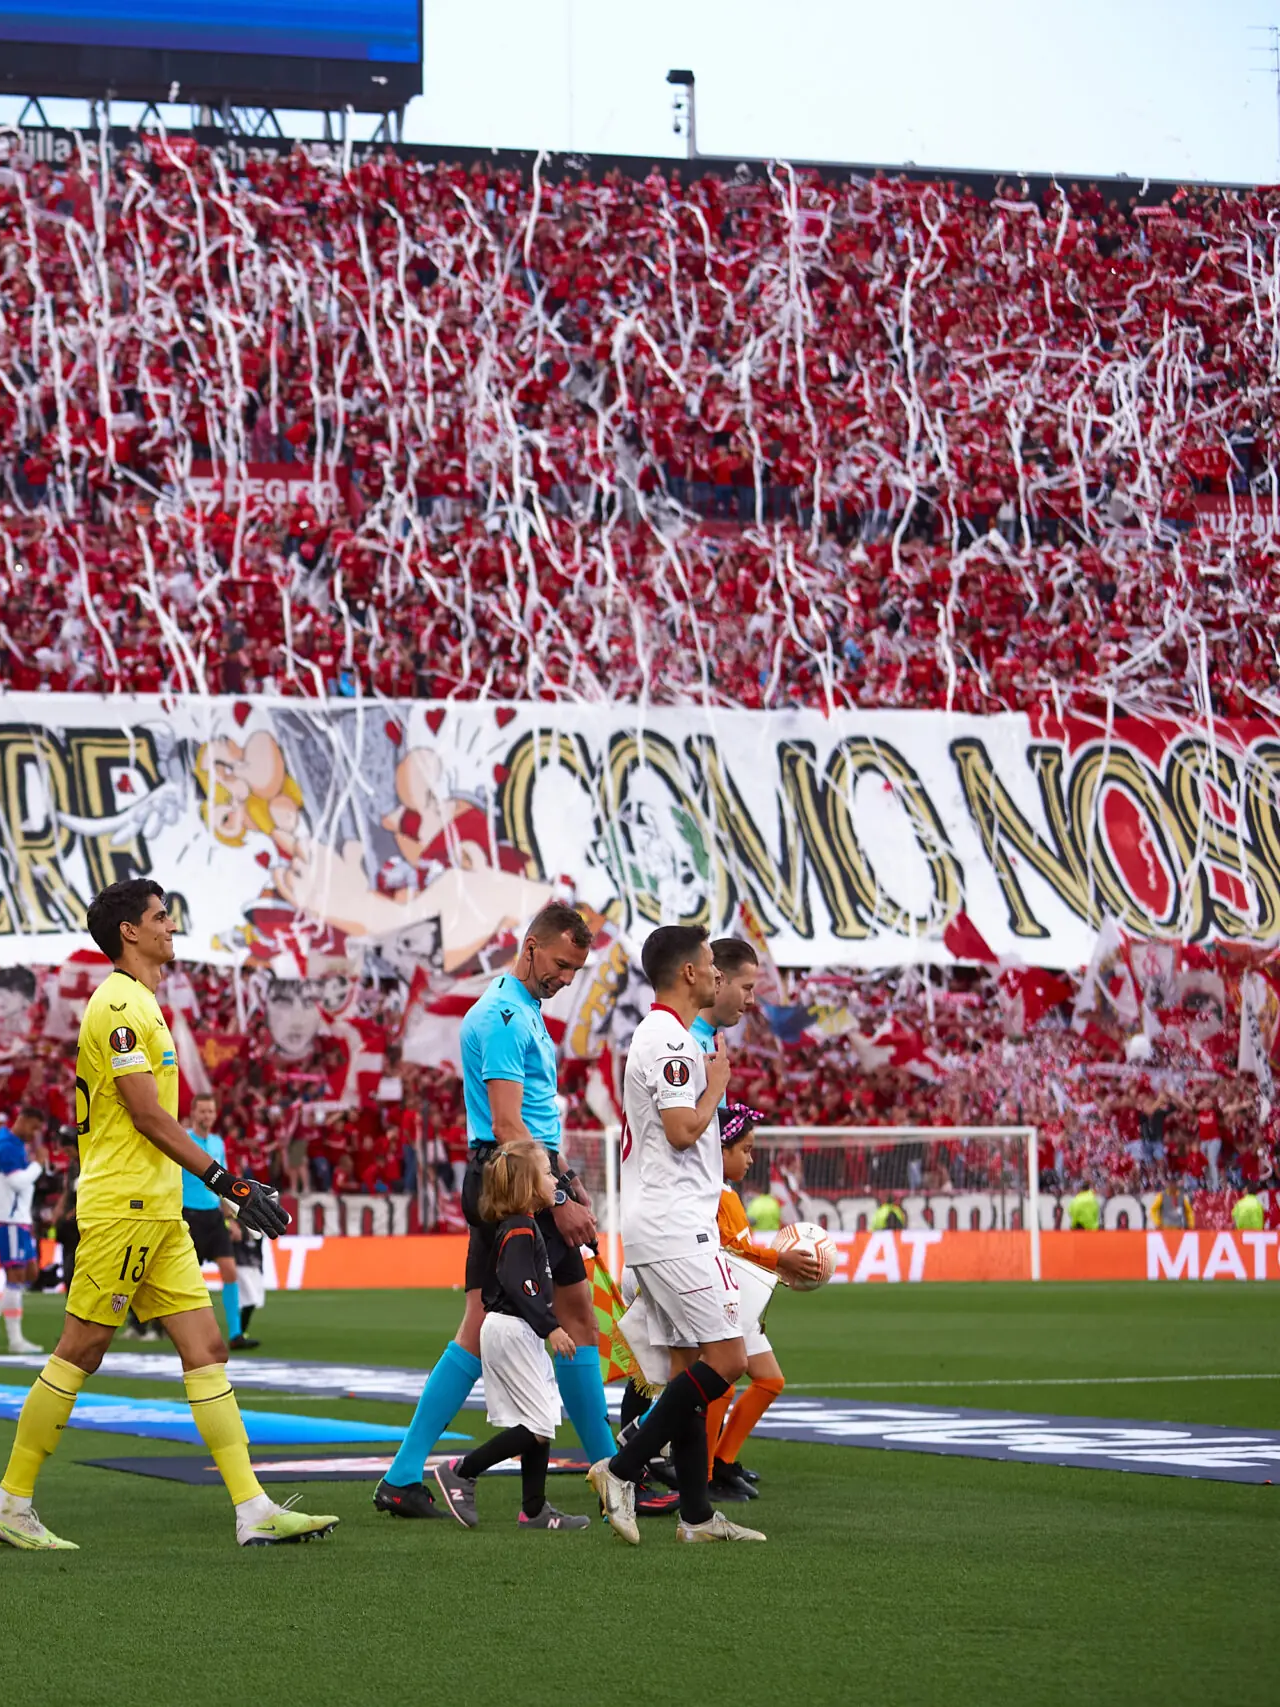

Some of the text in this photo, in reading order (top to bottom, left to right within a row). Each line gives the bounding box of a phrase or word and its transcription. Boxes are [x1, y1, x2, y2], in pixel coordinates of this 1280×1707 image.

[494, 726, 966, 940] COMO
[948, 734, 1280, 946] NOS
[118, 1245, 150, 1283] 13
[1145, 1231, 1280, 1281] MAT
